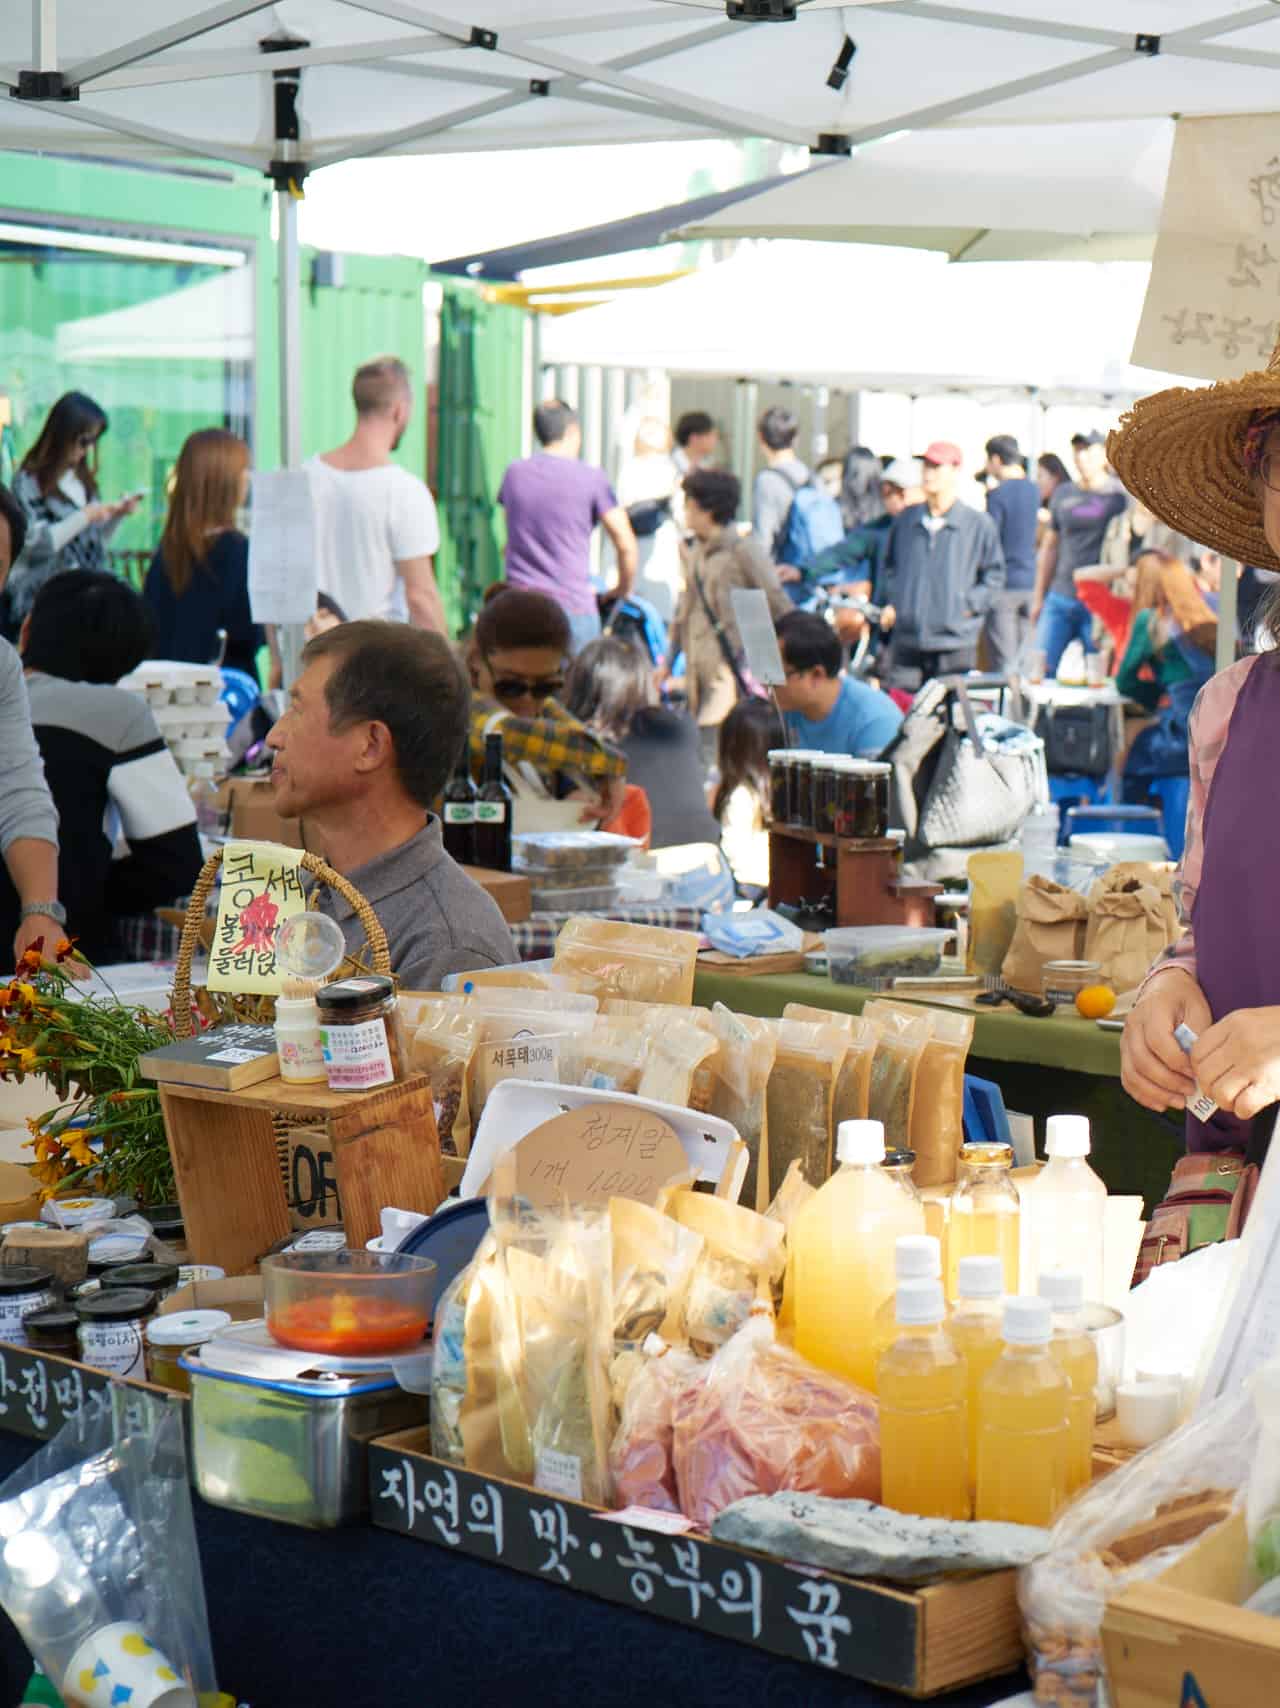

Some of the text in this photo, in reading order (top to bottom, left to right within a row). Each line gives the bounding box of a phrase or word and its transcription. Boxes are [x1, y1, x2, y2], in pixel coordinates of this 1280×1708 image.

[580, 1111, 673, 1160] 청계알
[378, 1458, 504, 1556] 자연의
[785, 1579, 852, 1669] 꿈
